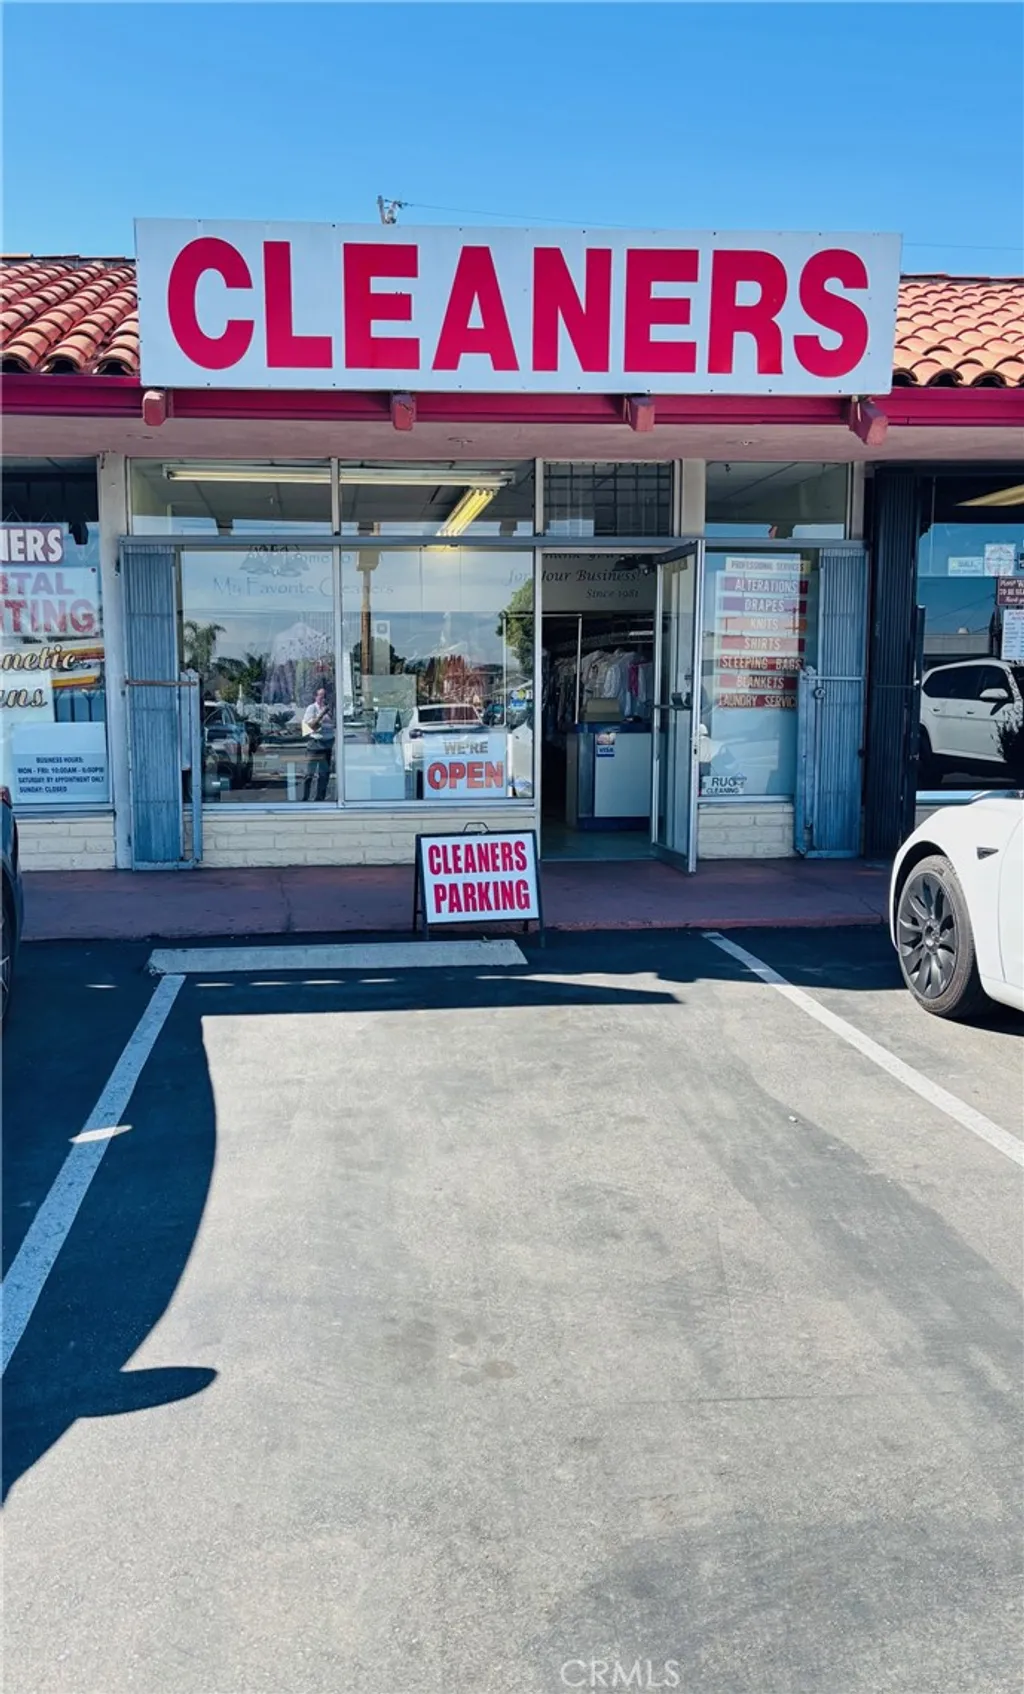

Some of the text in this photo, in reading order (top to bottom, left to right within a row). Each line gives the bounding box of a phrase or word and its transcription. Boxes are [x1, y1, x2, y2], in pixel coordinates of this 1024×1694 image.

[168, 236, 868, 378] CLEANERS
[247, 576, 315, 595] Favorite
[319, 577, 394, 597] Ceaers
[735, 578, 798, 593] ALTERATIONS
[586, 588, 614, 600] Since
[745, 598, 785, 612] DRAPES
[0, 599, 96, 632] TING
[750, 616, 779, 630] KNITS
[744, 638, 782, 651] SHIRTS
[722, 655, 801, 671] SLEEPING BAGS
[736, 675, 785, 690] BLANKETS
[718, 693, 757, 708] LAUNDRY
[443, 741, 488, 755] WE'RE
[427, 761, 504, 790] OPEN
[428, 840, 528, 875] CLEANERS
[433, 879, 531, 914] PARKING
